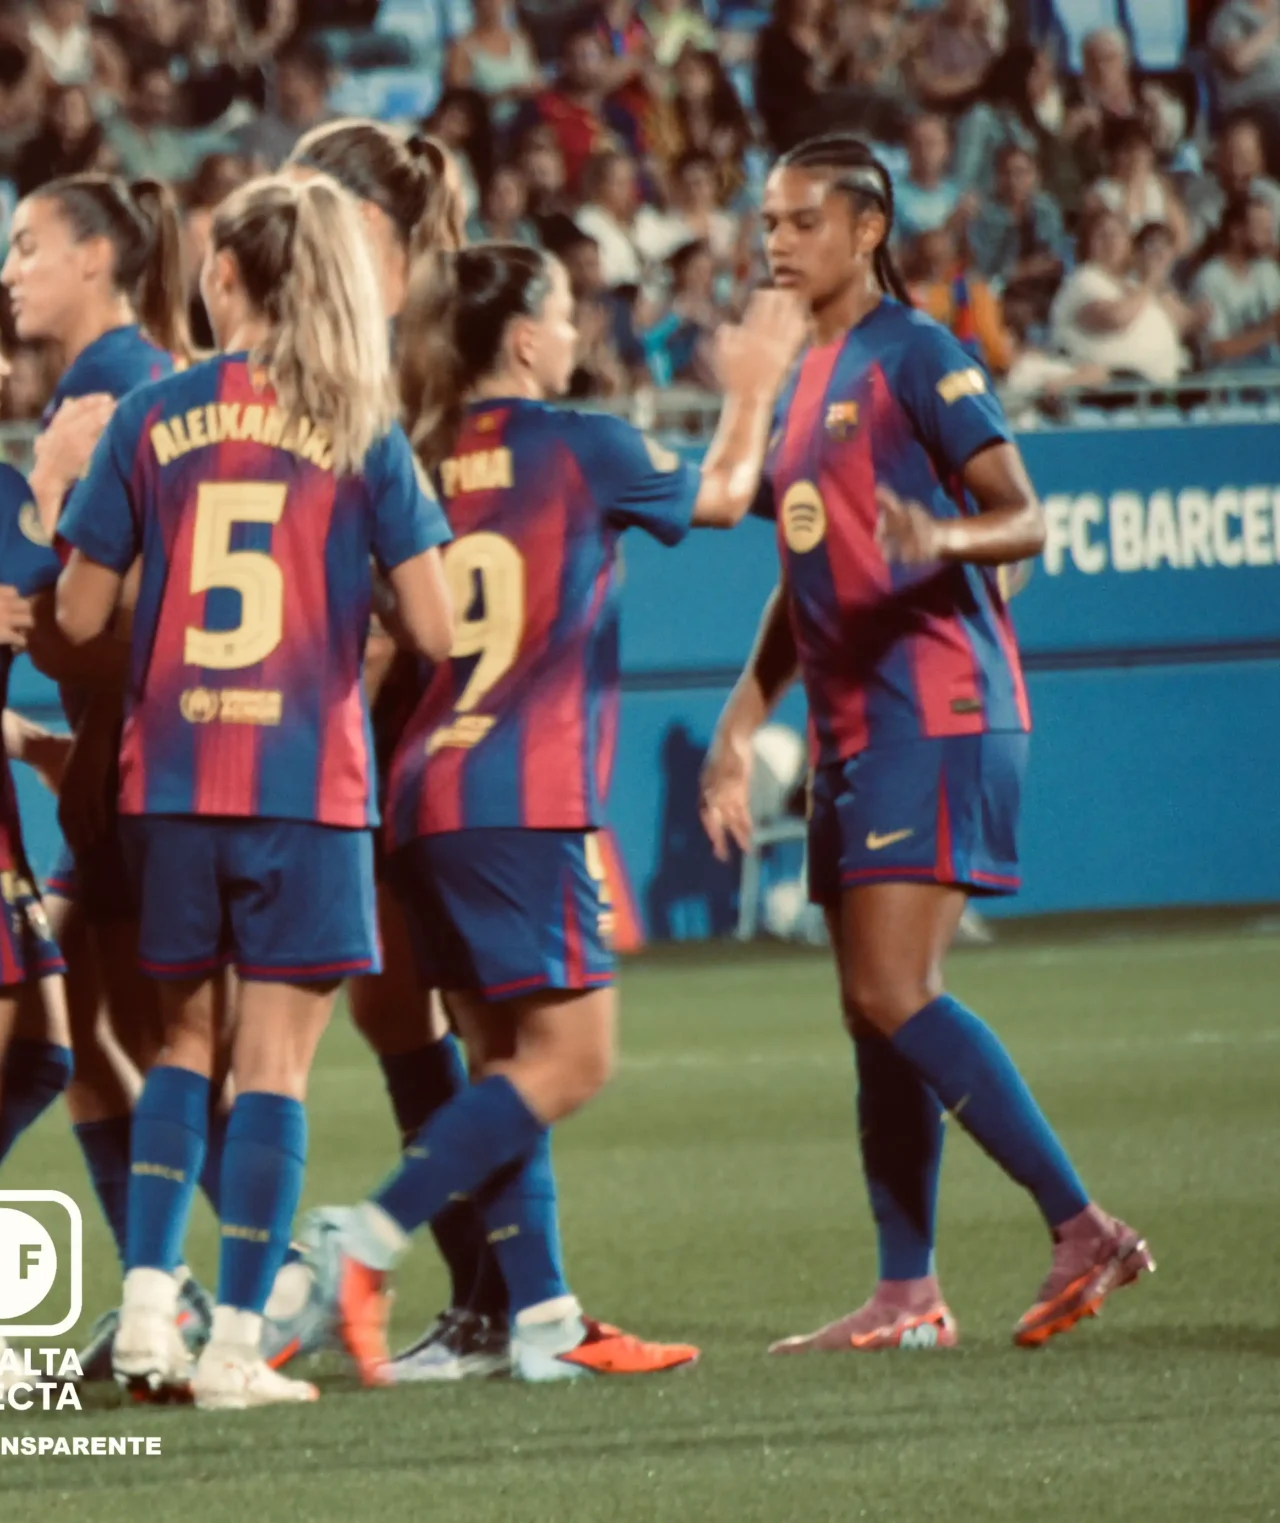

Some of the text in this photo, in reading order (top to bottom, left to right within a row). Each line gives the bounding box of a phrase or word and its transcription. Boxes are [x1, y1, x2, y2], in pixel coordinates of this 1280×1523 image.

[183, 481, 288, 670] 5
[441, 531, 525, 712] 9
[1043, 486, 1280, 576] FC BARCE
